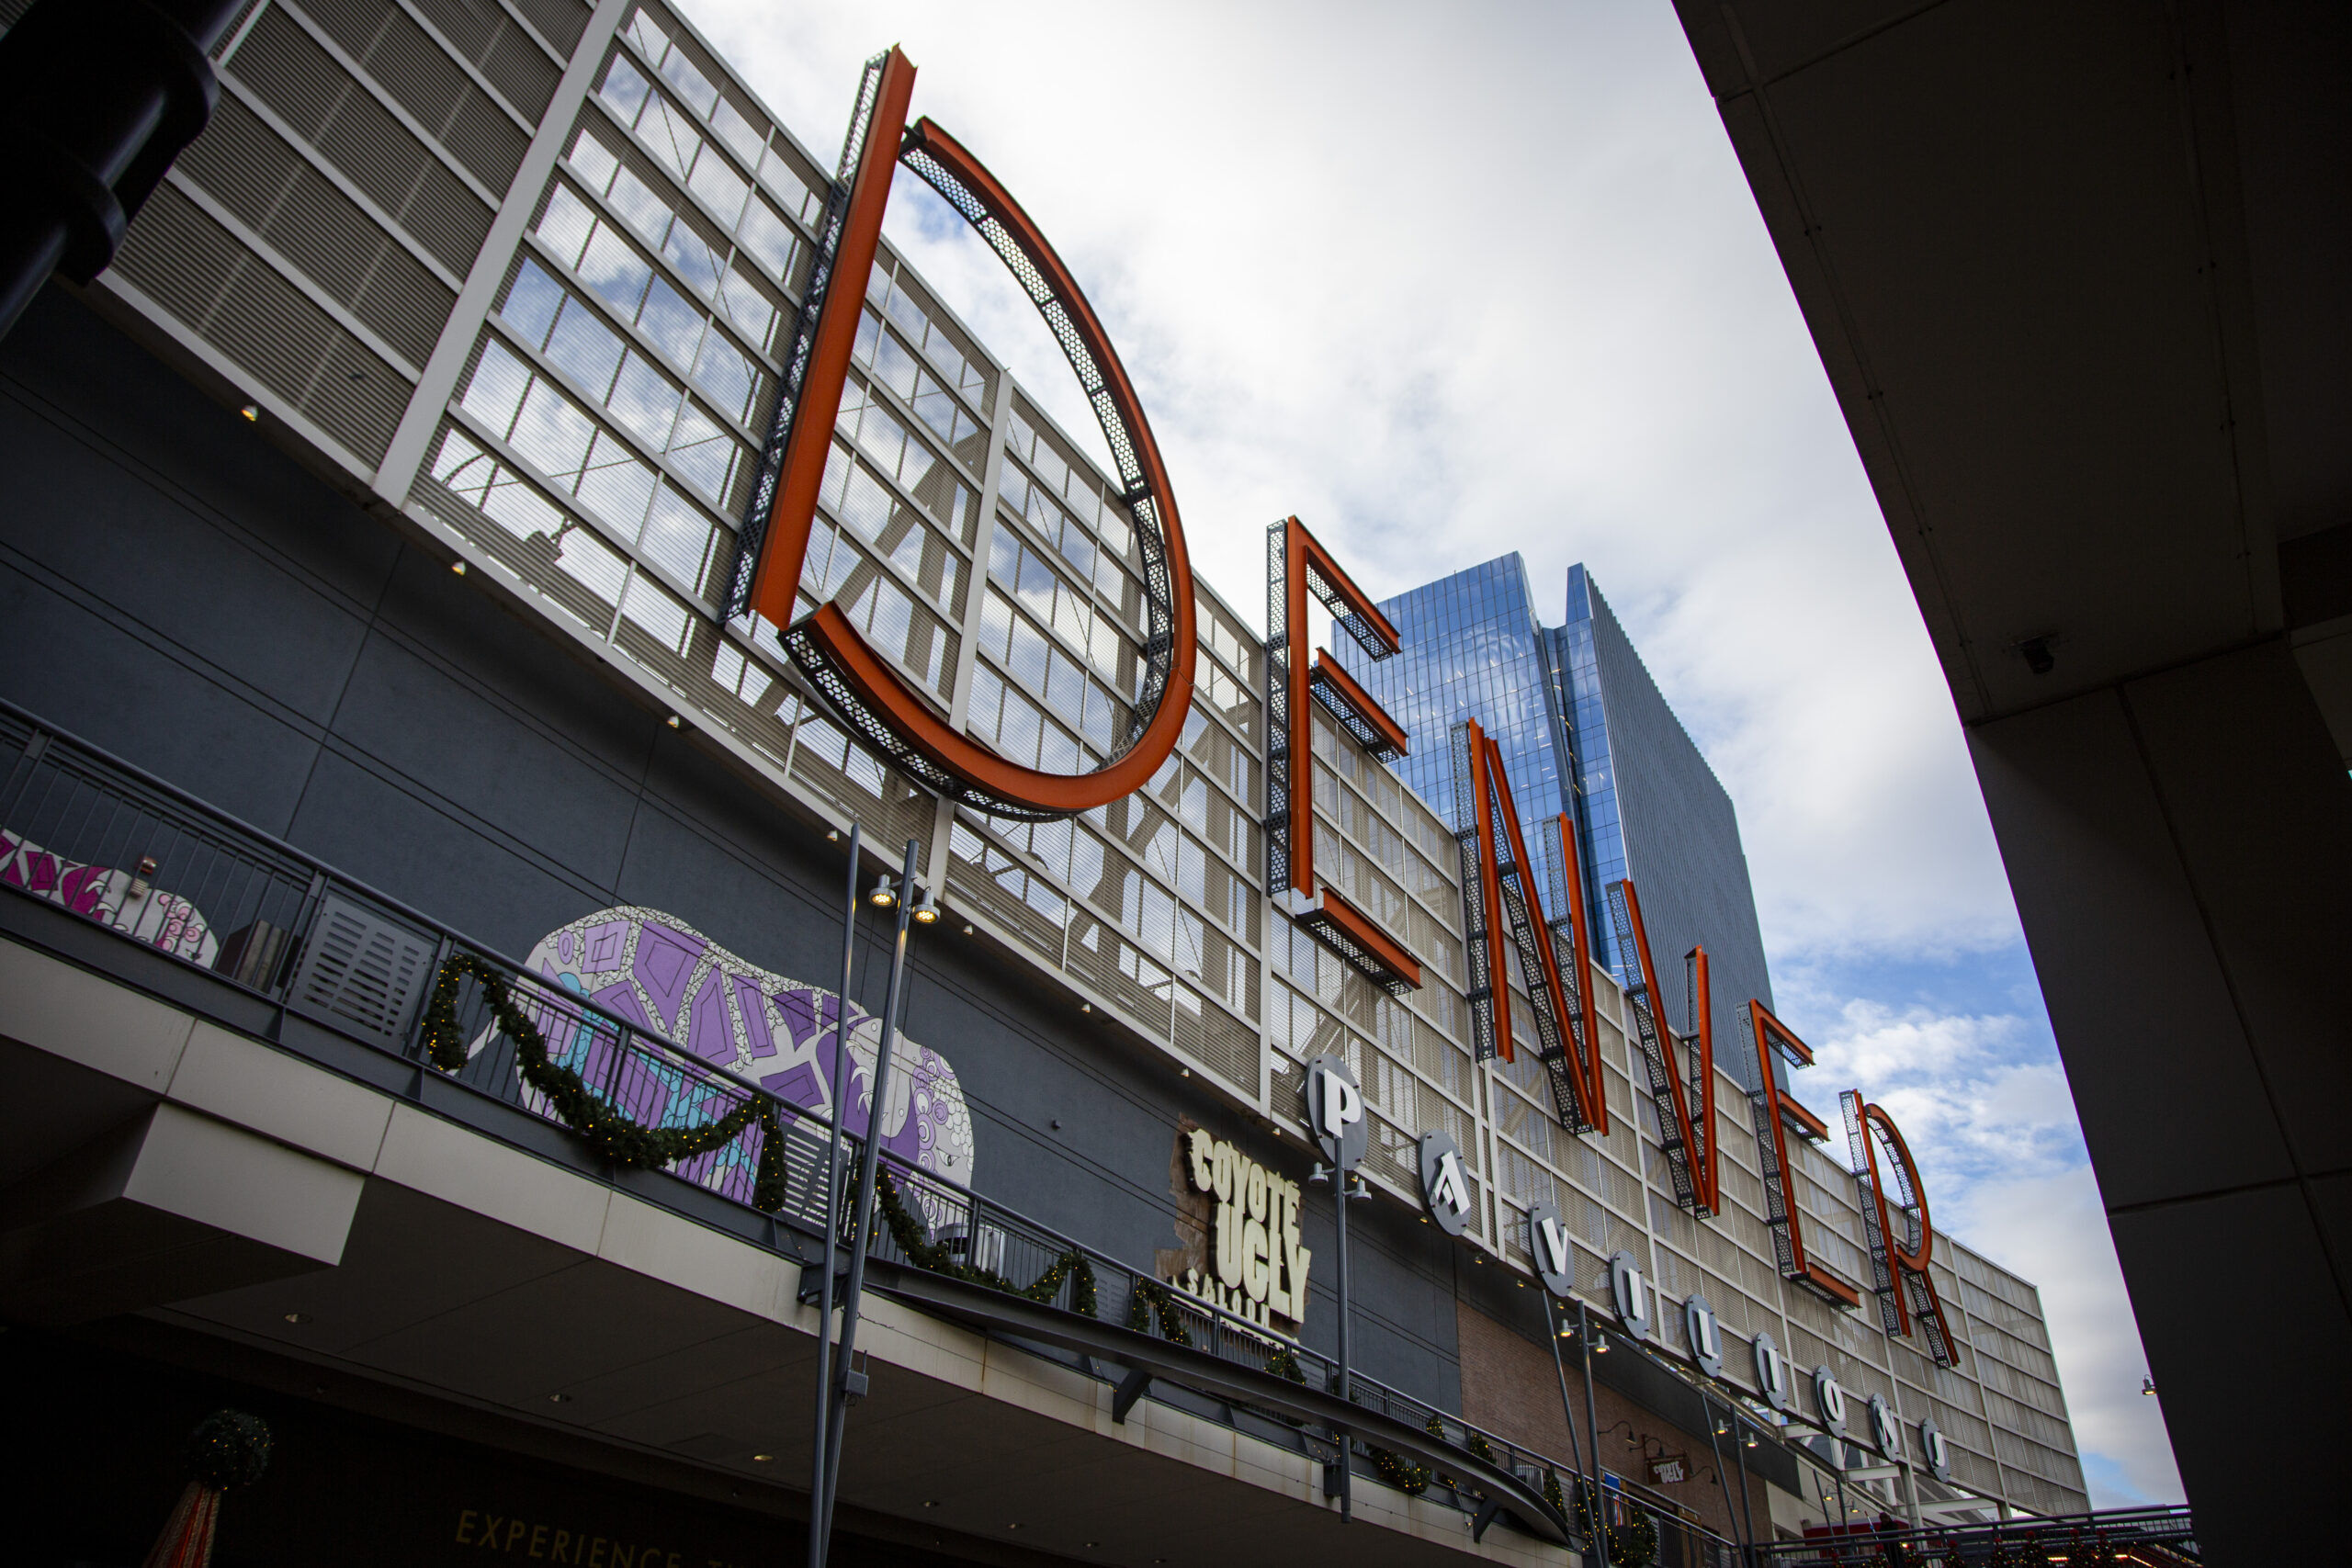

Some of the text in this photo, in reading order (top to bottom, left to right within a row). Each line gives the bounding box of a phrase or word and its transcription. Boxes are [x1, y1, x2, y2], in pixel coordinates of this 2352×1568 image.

[726, 42, 1961, 1369] DENVER
[1187, 1128, 1301, 1247] COYOTE
[1187, 1267, 1271, 1329] SALOON
[1216, 1200, 1311, 1324] UGLY
[1324, 1068, 1947, 1467] PAVILIONS
[1654, 1461, 1680, 1475] COYOTE
[1661, 1468, 1683, 1483] UGLY
